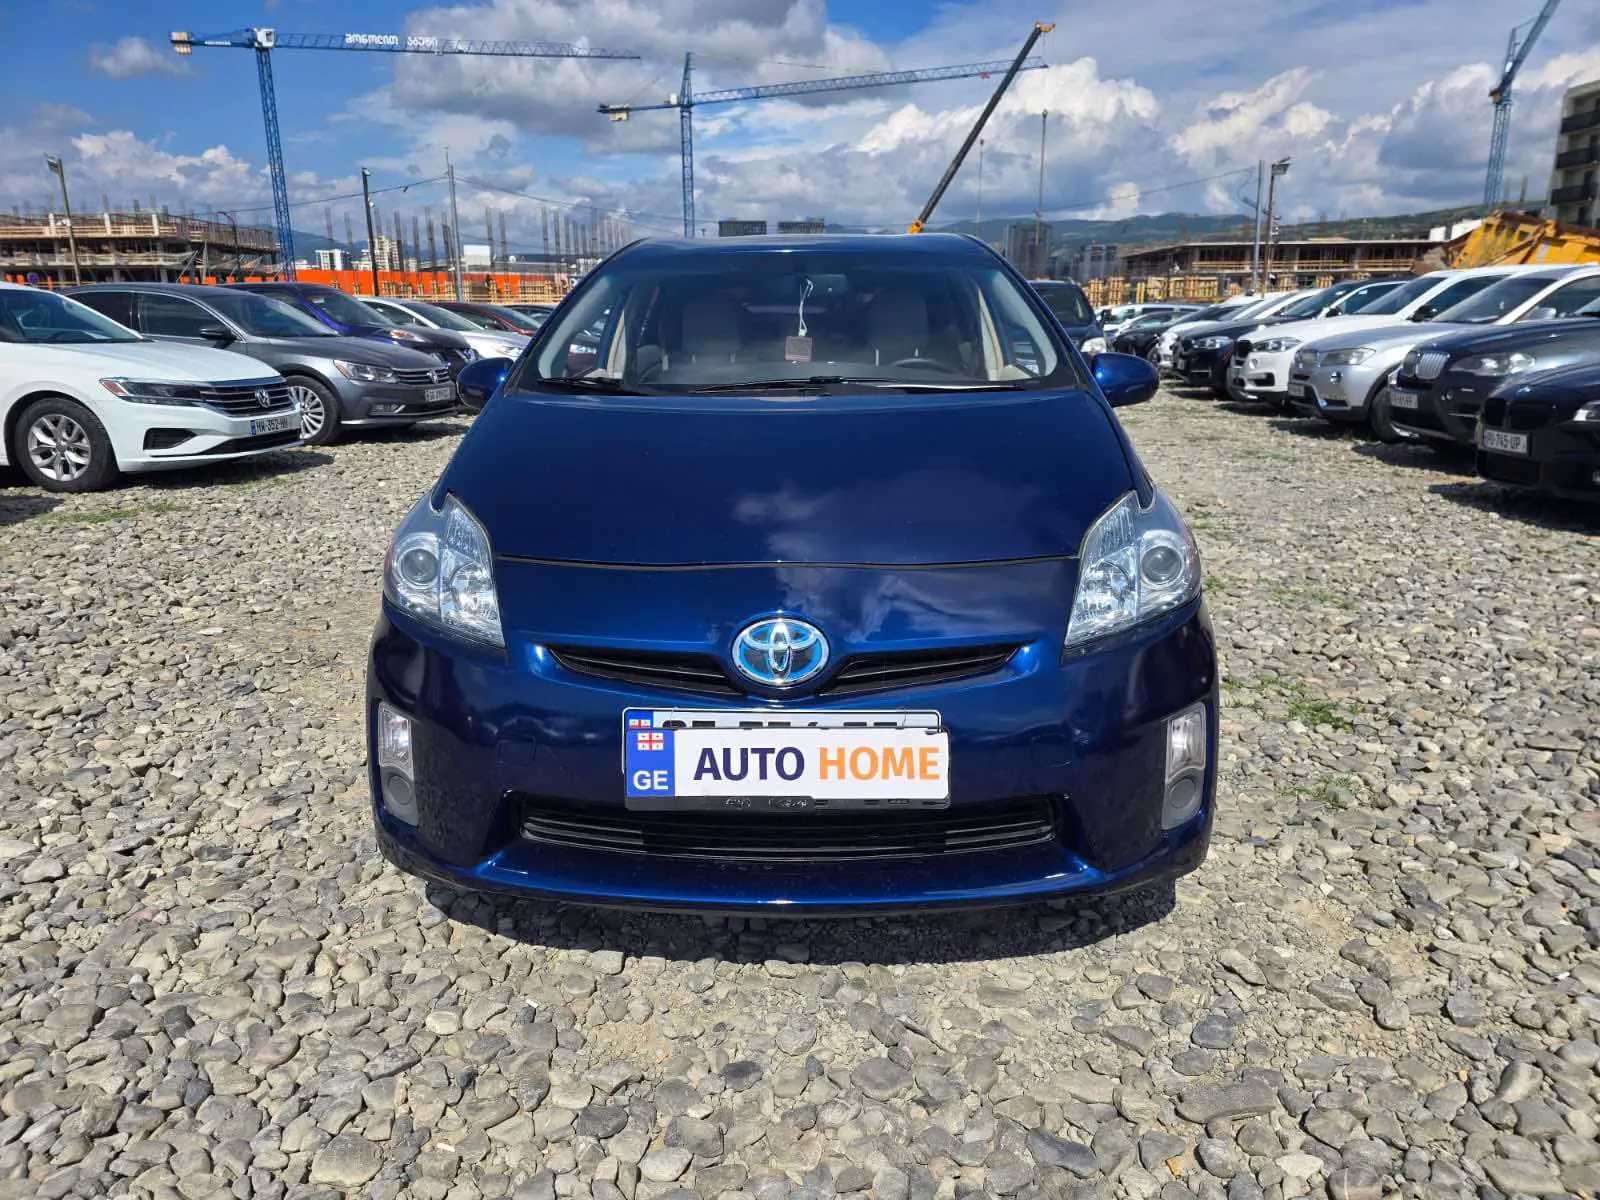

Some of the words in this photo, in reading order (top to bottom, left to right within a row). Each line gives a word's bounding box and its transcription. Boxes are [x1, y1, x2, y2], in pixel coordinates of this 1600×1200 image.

[693, 747, 805, 781] AUTO
[819, 747, 939, 780] HOME
[633, 770, 669, 791] GE
